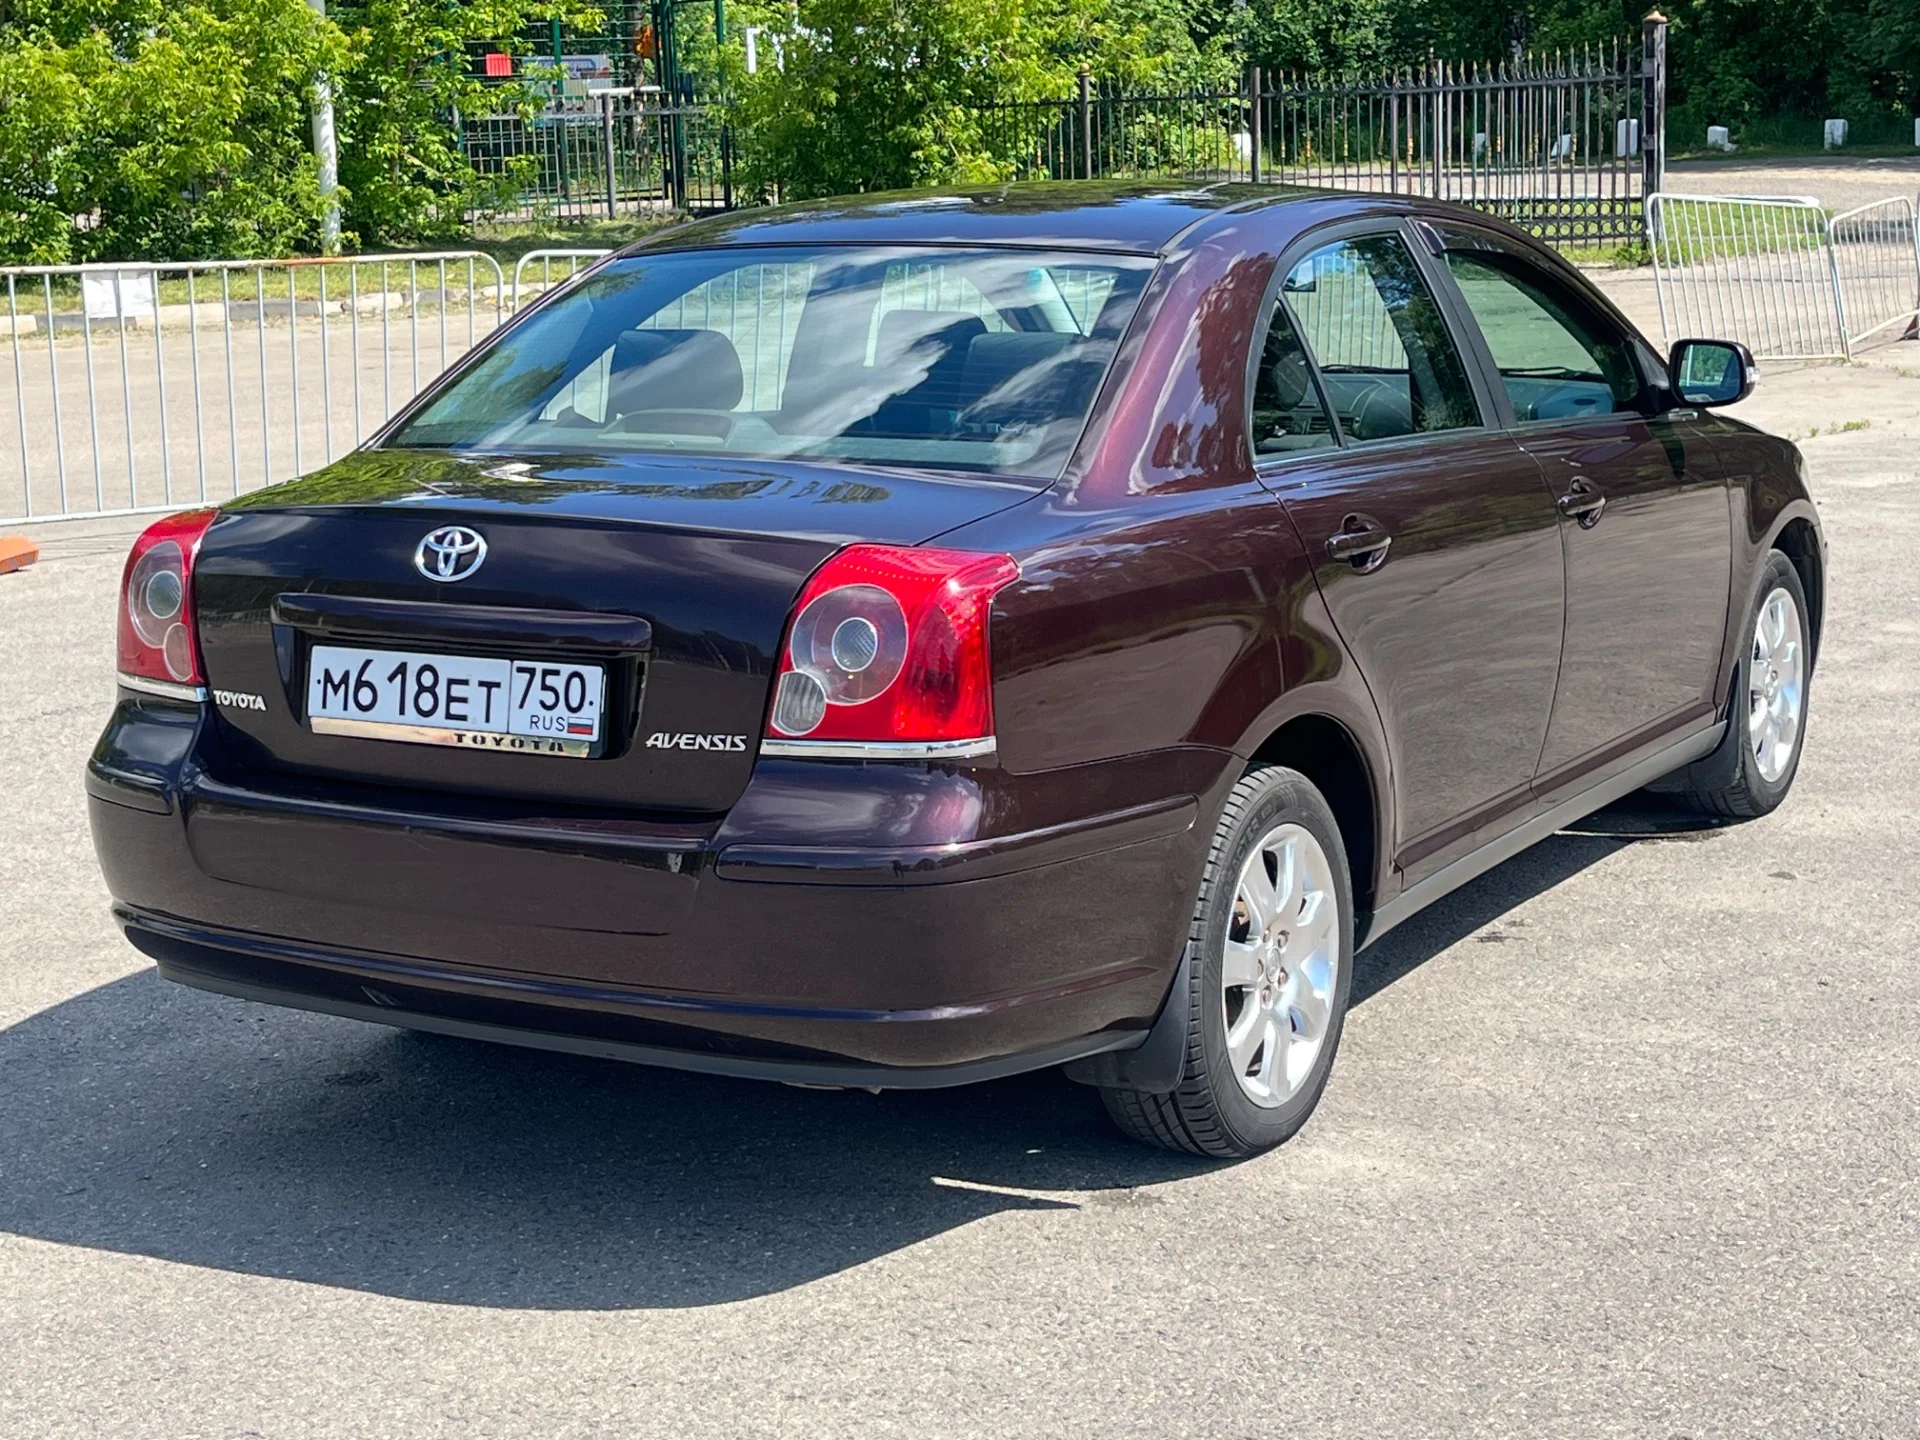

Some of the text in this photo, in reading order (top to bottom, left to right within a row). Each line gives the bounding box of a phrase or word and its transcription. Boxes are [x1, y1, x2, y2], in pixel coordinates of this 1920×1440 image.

[213, 690, 267, 711] TOYOTA
[516, 666, 587, 714] 750
[529, 714, 566, 732] RUS
[454, 732, 564, 753] TOYOTA
[645, 732, 747, 752] AVENSIS
